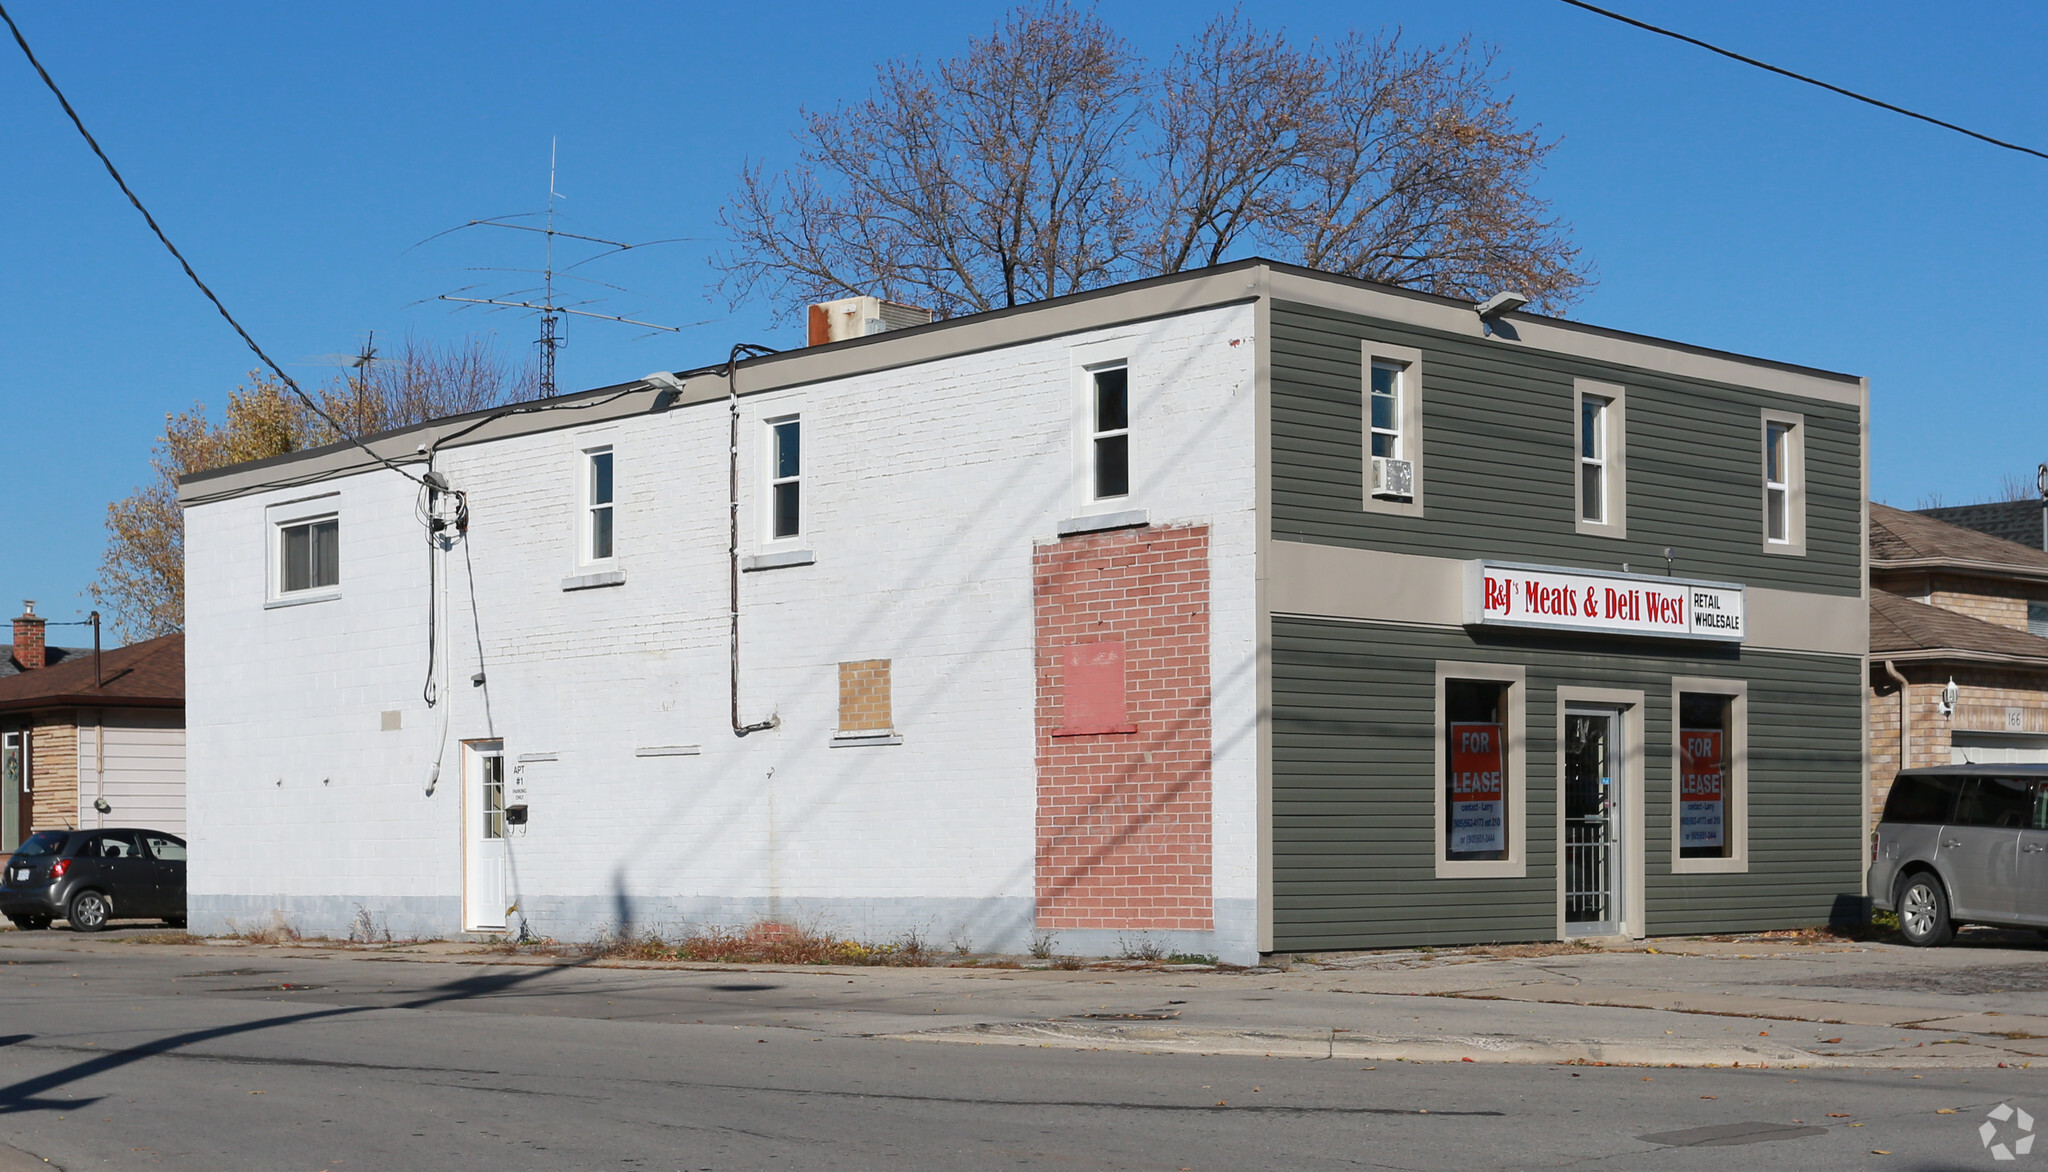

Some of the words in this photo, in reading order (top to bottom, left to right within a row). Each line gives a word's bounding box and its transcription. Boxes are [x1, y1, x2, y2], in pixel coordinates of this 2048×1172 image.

[1484, 577, 1519, 615] R&J's
[1525, 580, 1577, 616] Meats
[1583, 586, 1598, 618] &
[1605, 588, 1640, 621] Deli
[1645, 591, 1684, 625] West
[1694, 593, 1721, 610] RETAIL
[1694, 612, 1740, 630] WHOLESALE
[2007, 712, 2021, 726] 166
[1462, 732, 1490, 753] FOR
[1688, 737, 1712, 757] FOR
[513, 765, 525, 774] APT
[516, 777, 523, 785] #1
[1453, 771, 1500, 794] LEASE
[1681, 774, 1720, 794] LEASE
[1481, 802, 1493, 813] Larry
